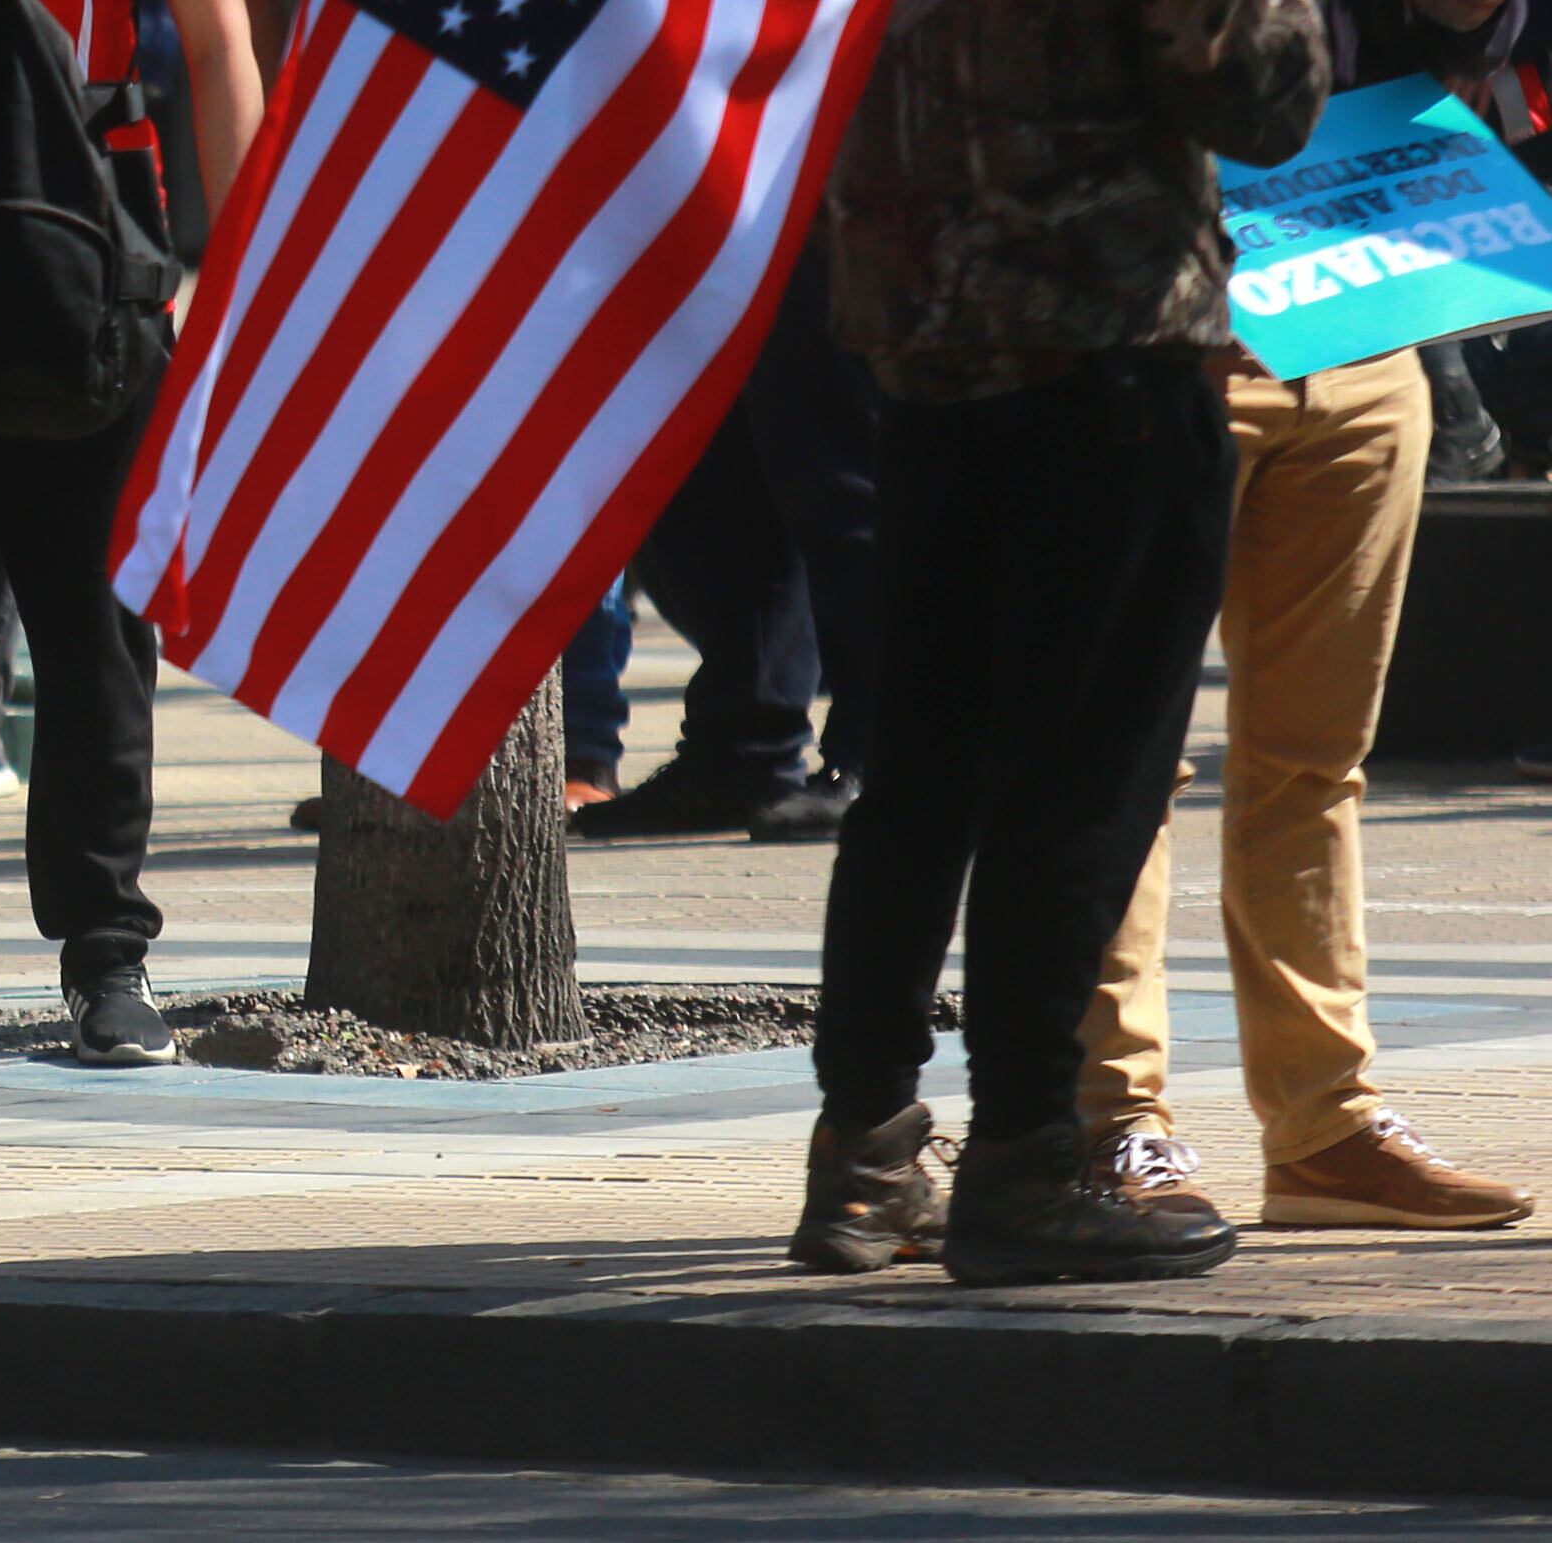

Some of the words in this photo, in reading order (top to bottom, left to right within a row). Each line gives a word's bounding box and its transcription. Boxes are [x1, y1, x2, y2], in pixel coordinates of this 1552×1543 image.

[1395, 168, 1488, 206] DOS
[1235, 222, 1275, 254] D
[1228, 202, 1552, 316] RECHAZO
